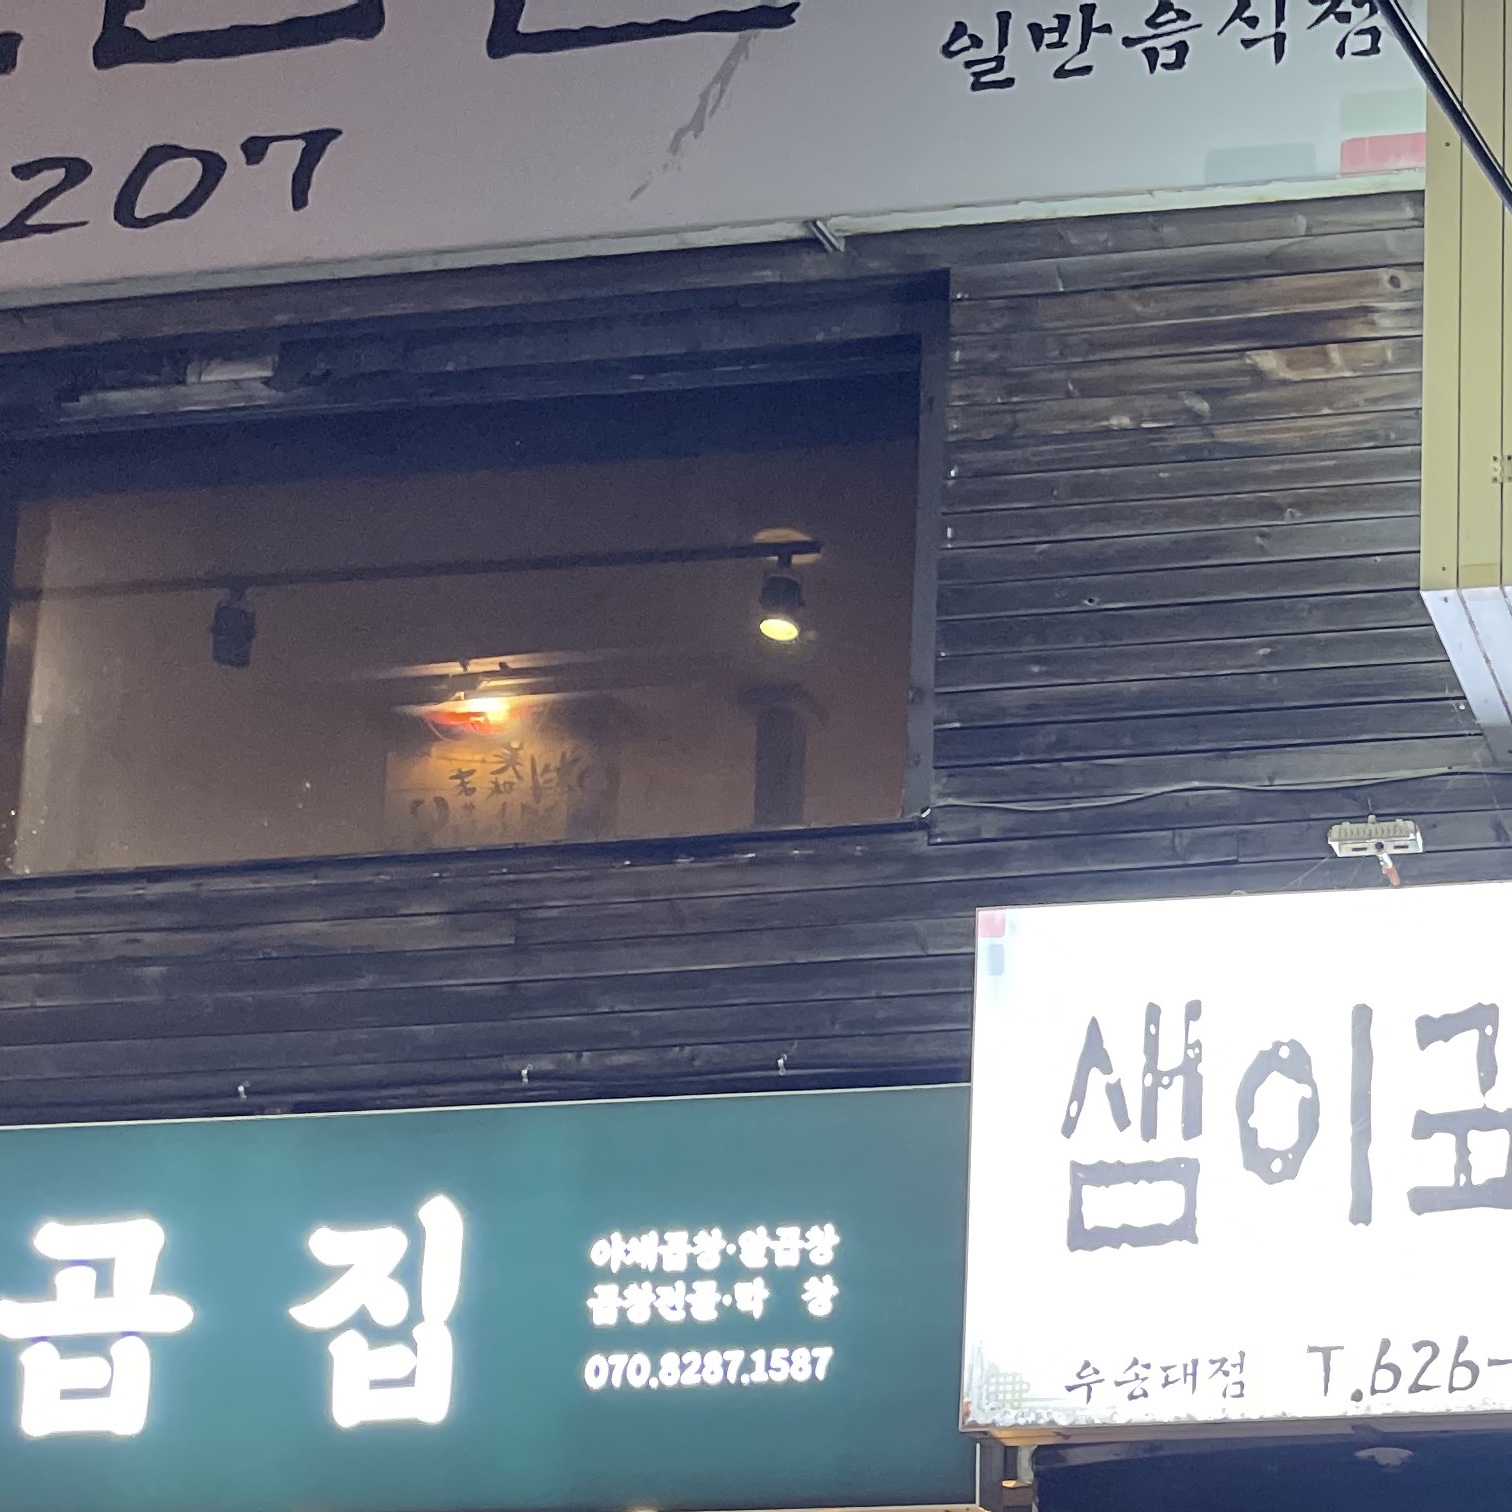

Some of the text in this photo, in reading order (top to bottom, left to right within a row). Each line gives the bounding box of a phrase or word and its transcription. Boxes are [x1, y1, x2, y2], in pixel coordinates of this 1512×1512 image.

[941, 0, 1382, 91] 일반음식점
[0, 128, 343, 242] 207
[584, 1346, 835, 1391] 070.8287.1587
[1065, 1349, 1248, 1402] 우송대점
